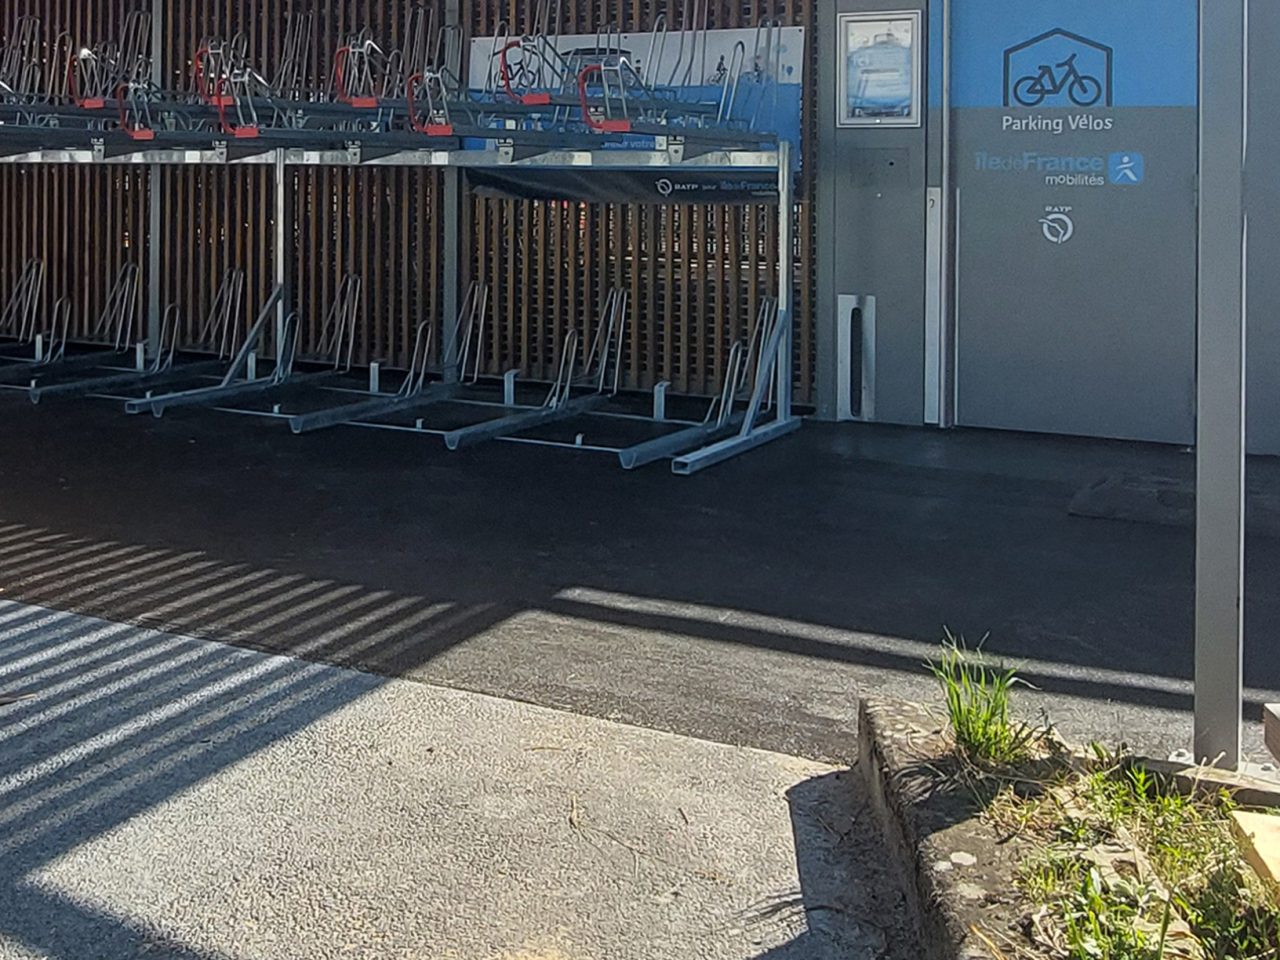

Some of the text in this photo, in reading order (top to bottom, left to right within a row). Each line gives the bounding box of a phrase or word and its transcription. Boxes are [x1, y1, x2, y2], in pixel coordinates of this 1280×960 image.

[1002, 114, 1113, 134] Parking Vélos
[1045, 173, 1104, 186] mobilités
